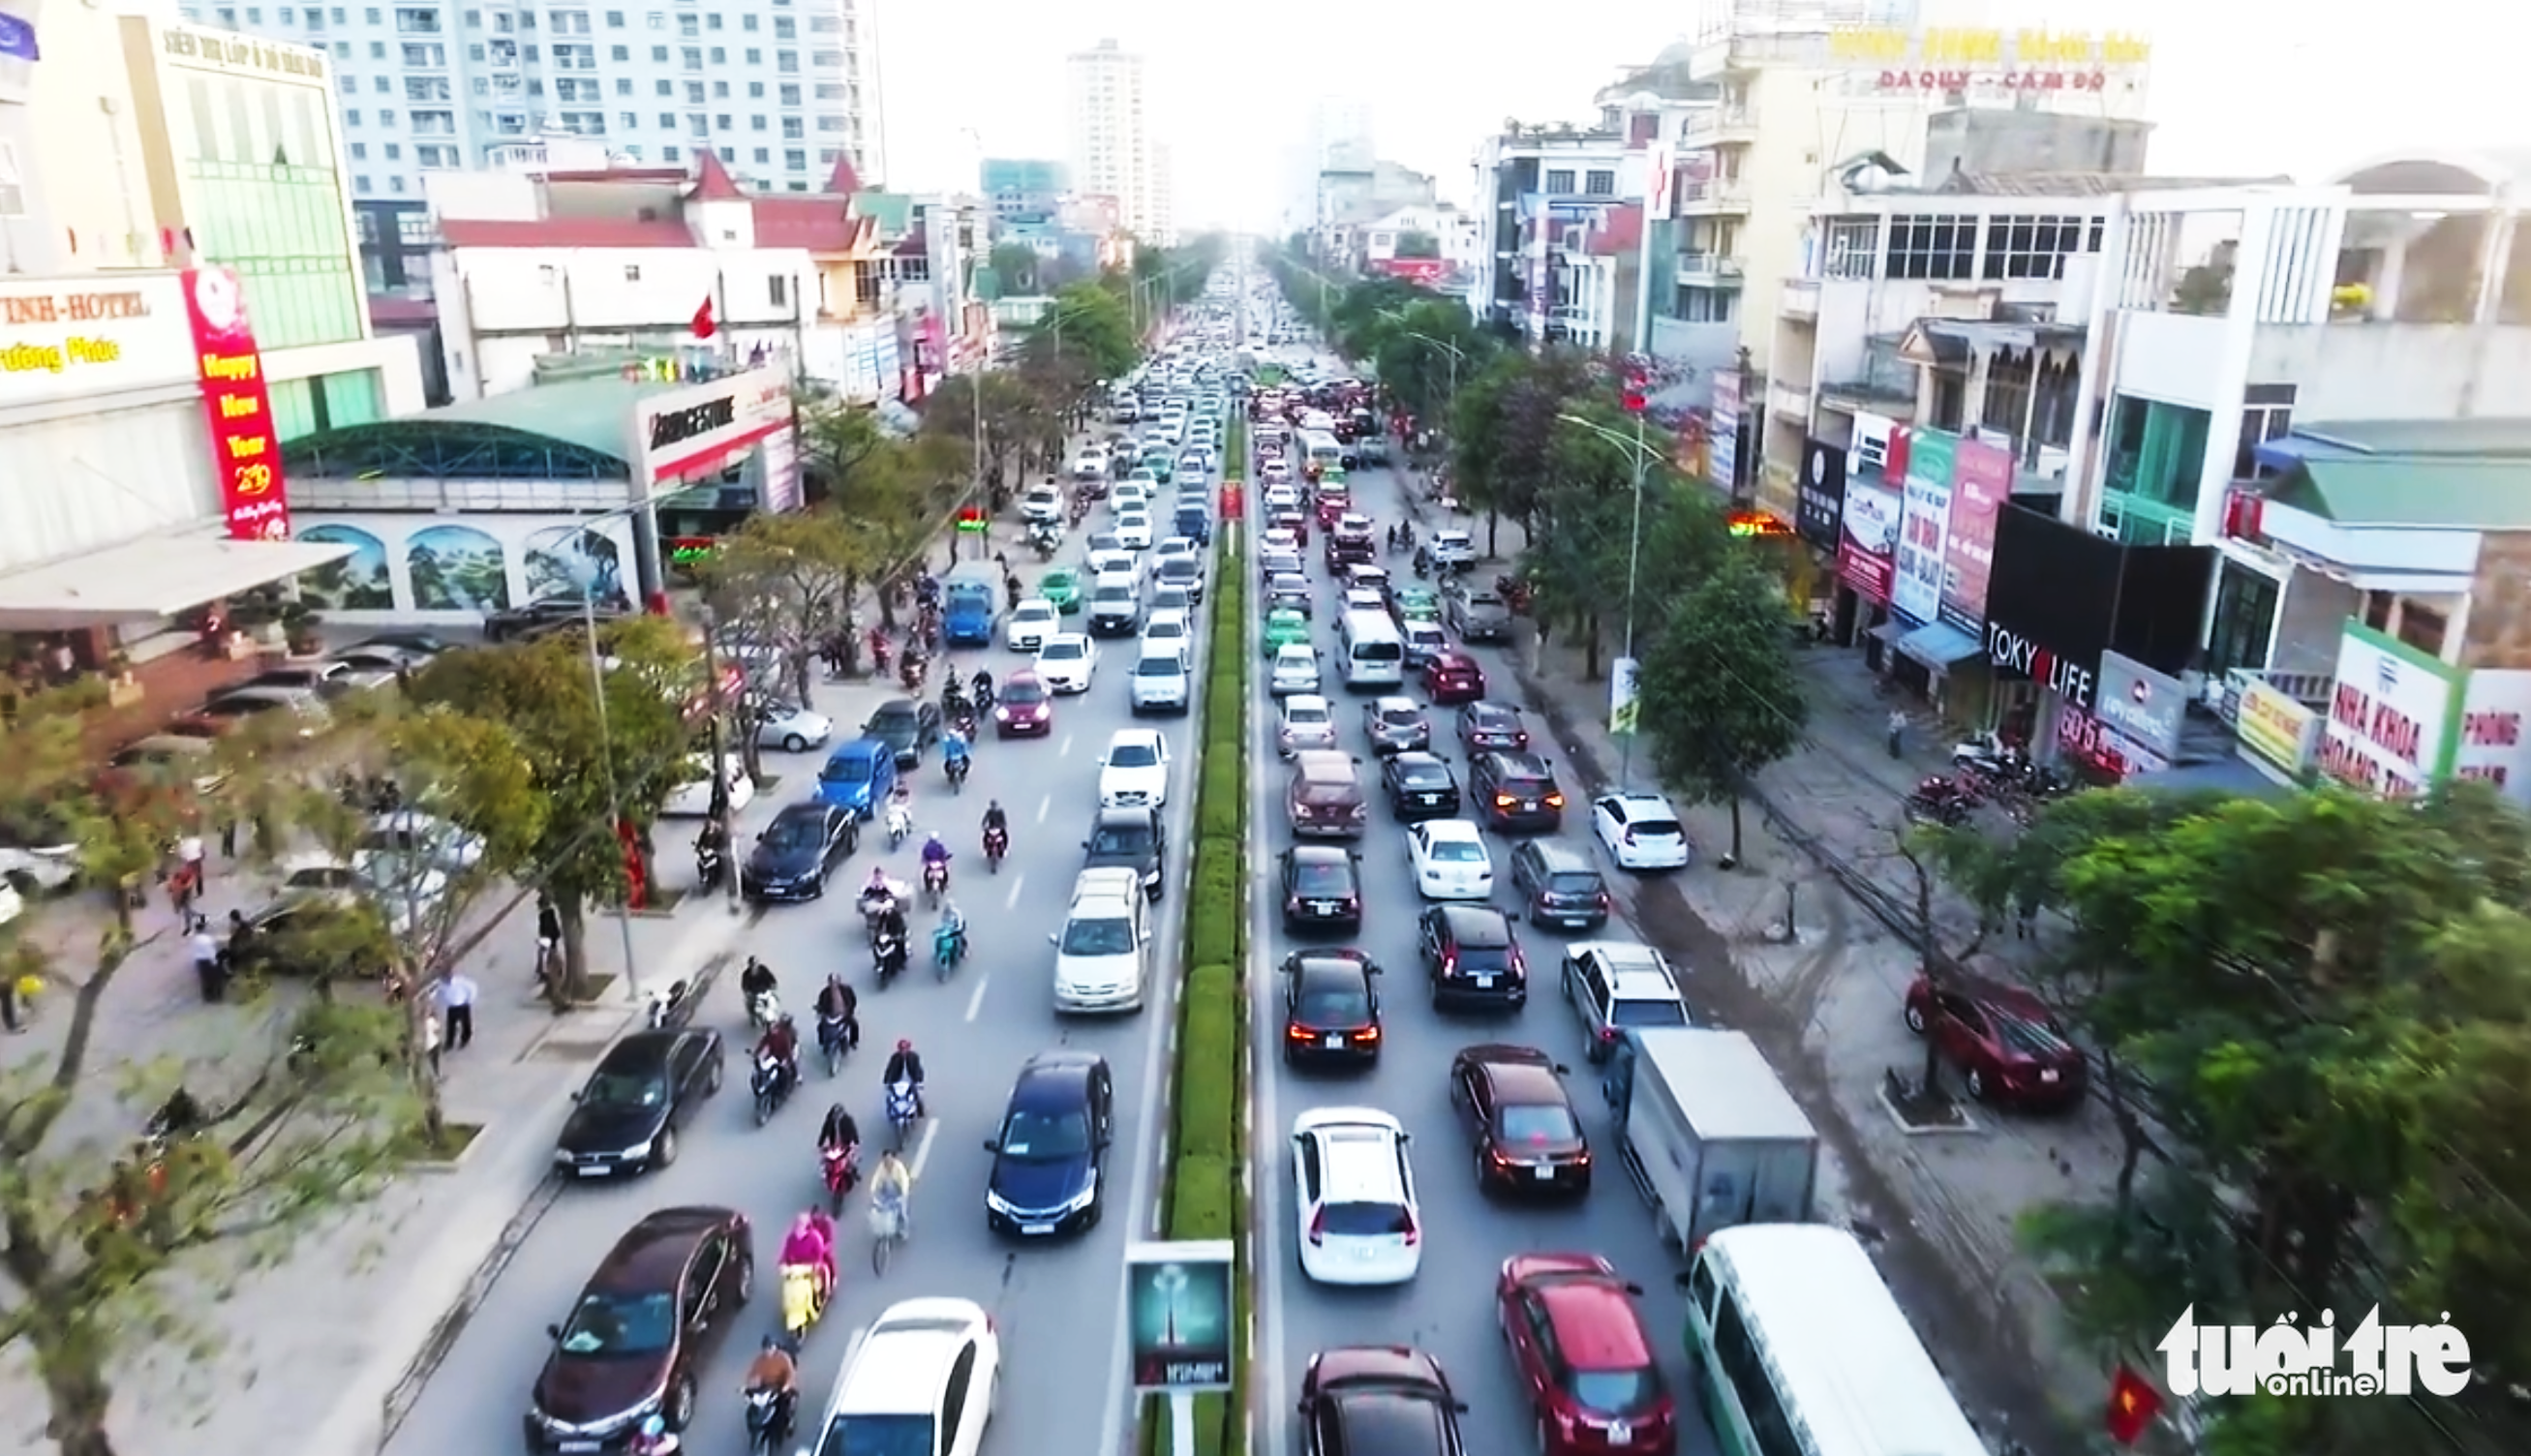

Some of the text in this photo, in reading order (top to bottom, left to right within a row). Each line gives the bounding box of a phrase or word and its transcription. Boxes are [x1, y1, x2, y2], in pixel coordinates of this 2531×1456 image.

[0, 291, 151, 324] INH-HOTEL
[202, 353, 257, 380] Happy
[220, 393, 259, 418] New
[227, 436, 265, 458] Year
[2333, 682, 2369, 736] NHA
[2370, 700, 2421, 768] KHOA
